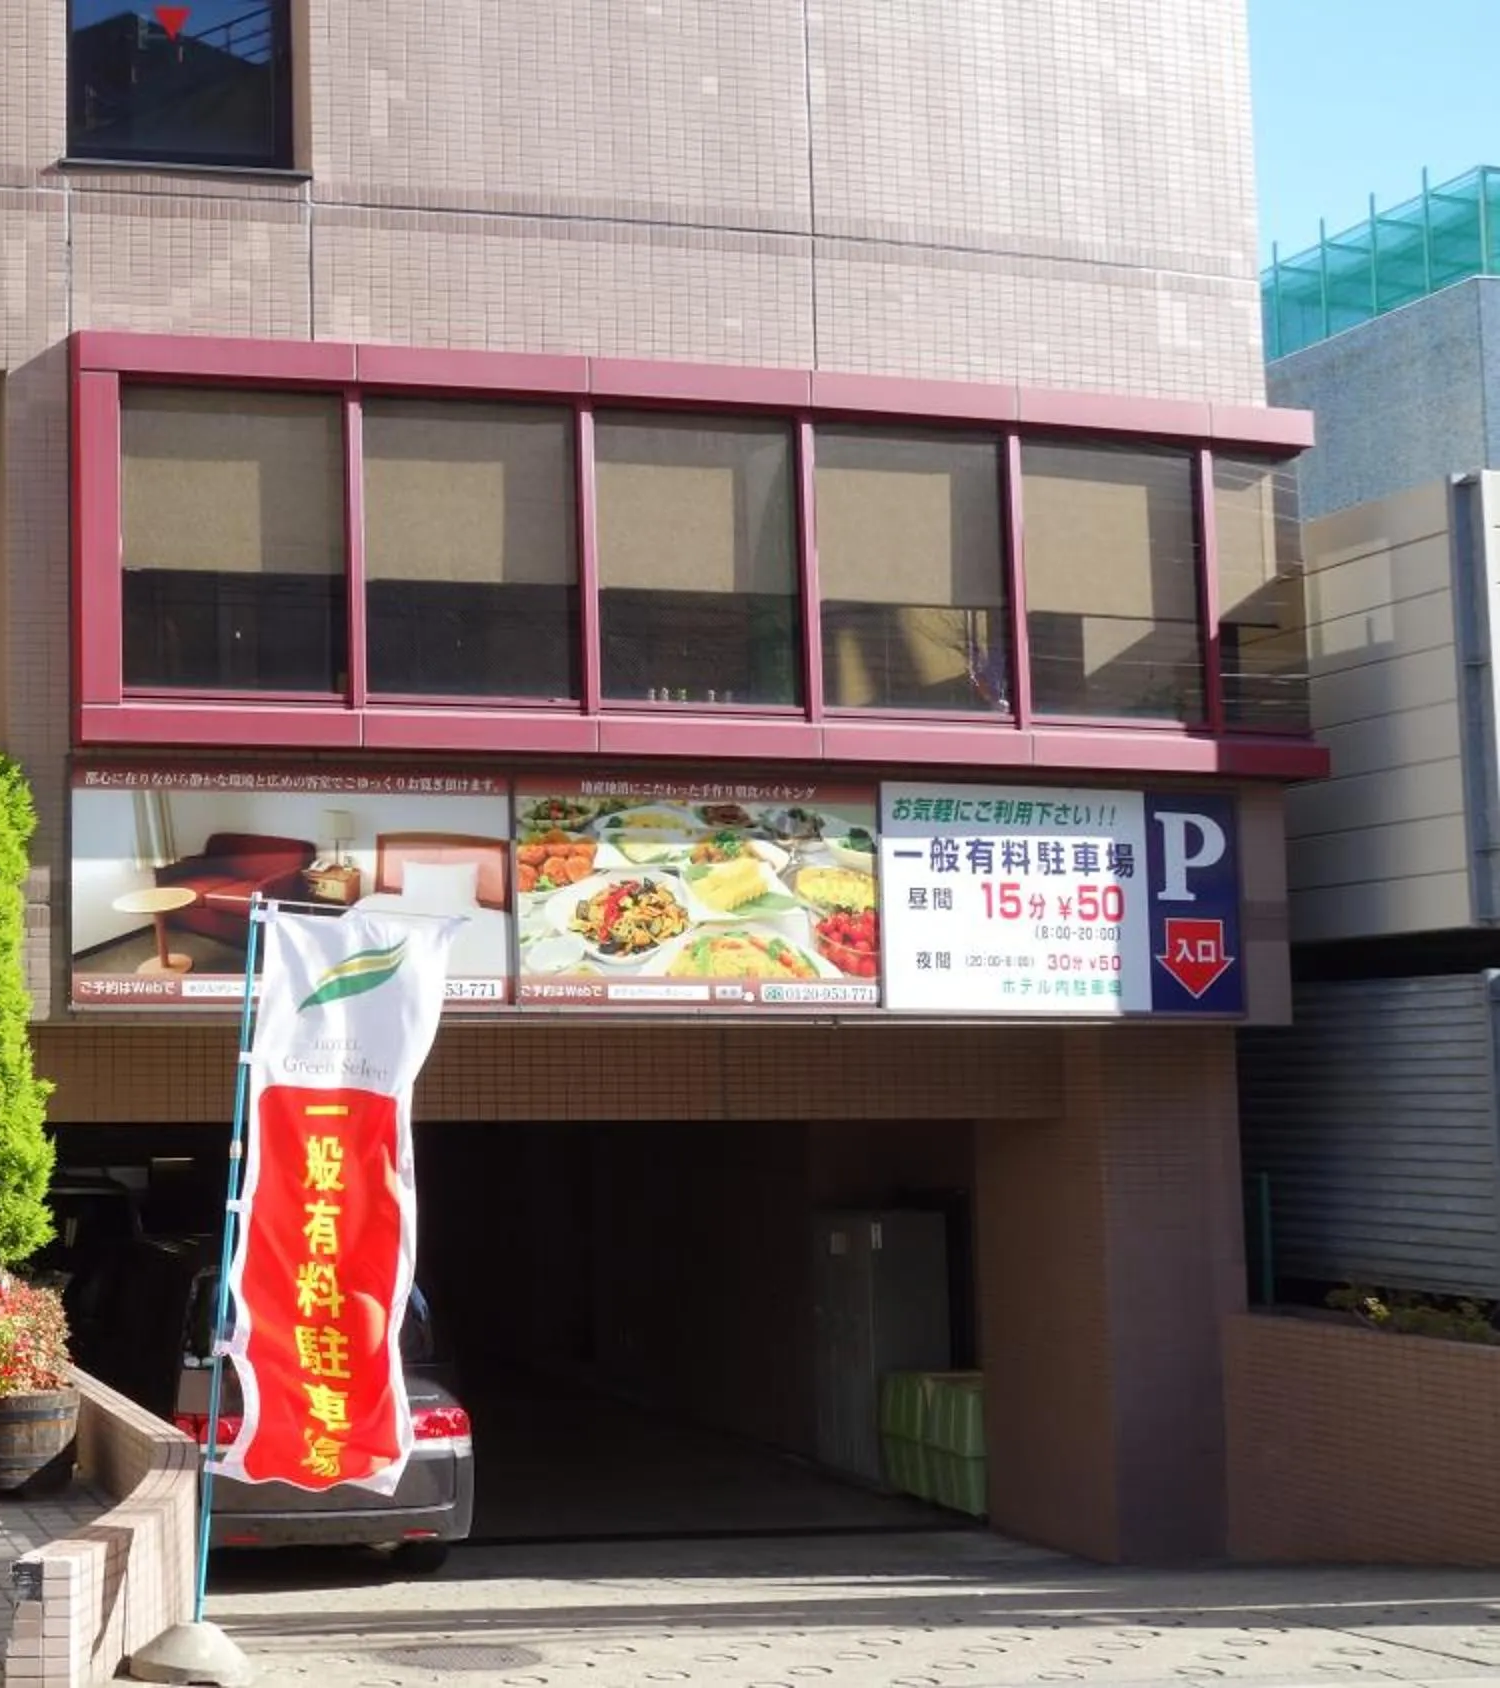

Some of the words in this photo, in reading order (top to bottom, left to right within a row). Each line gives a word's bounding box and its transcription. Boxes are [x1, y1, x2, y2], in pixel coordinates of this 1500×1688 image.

[893, 836, 1135, 879] 一般有料駐車場
[1153, 811, 1227, 901] P
[908, 887, 954, 911] 昼間
[981, 882, 1047, 920] 15分
[916, 951, 952, 970] 夜間
[1175, 939, 1216, 963] 入口
[1002, 978, 1123, 997] ホテル内駐車場
[283, 1054, 335, 1074] Green
[294, 1103, 352, 1478] 一般有料駐車場
